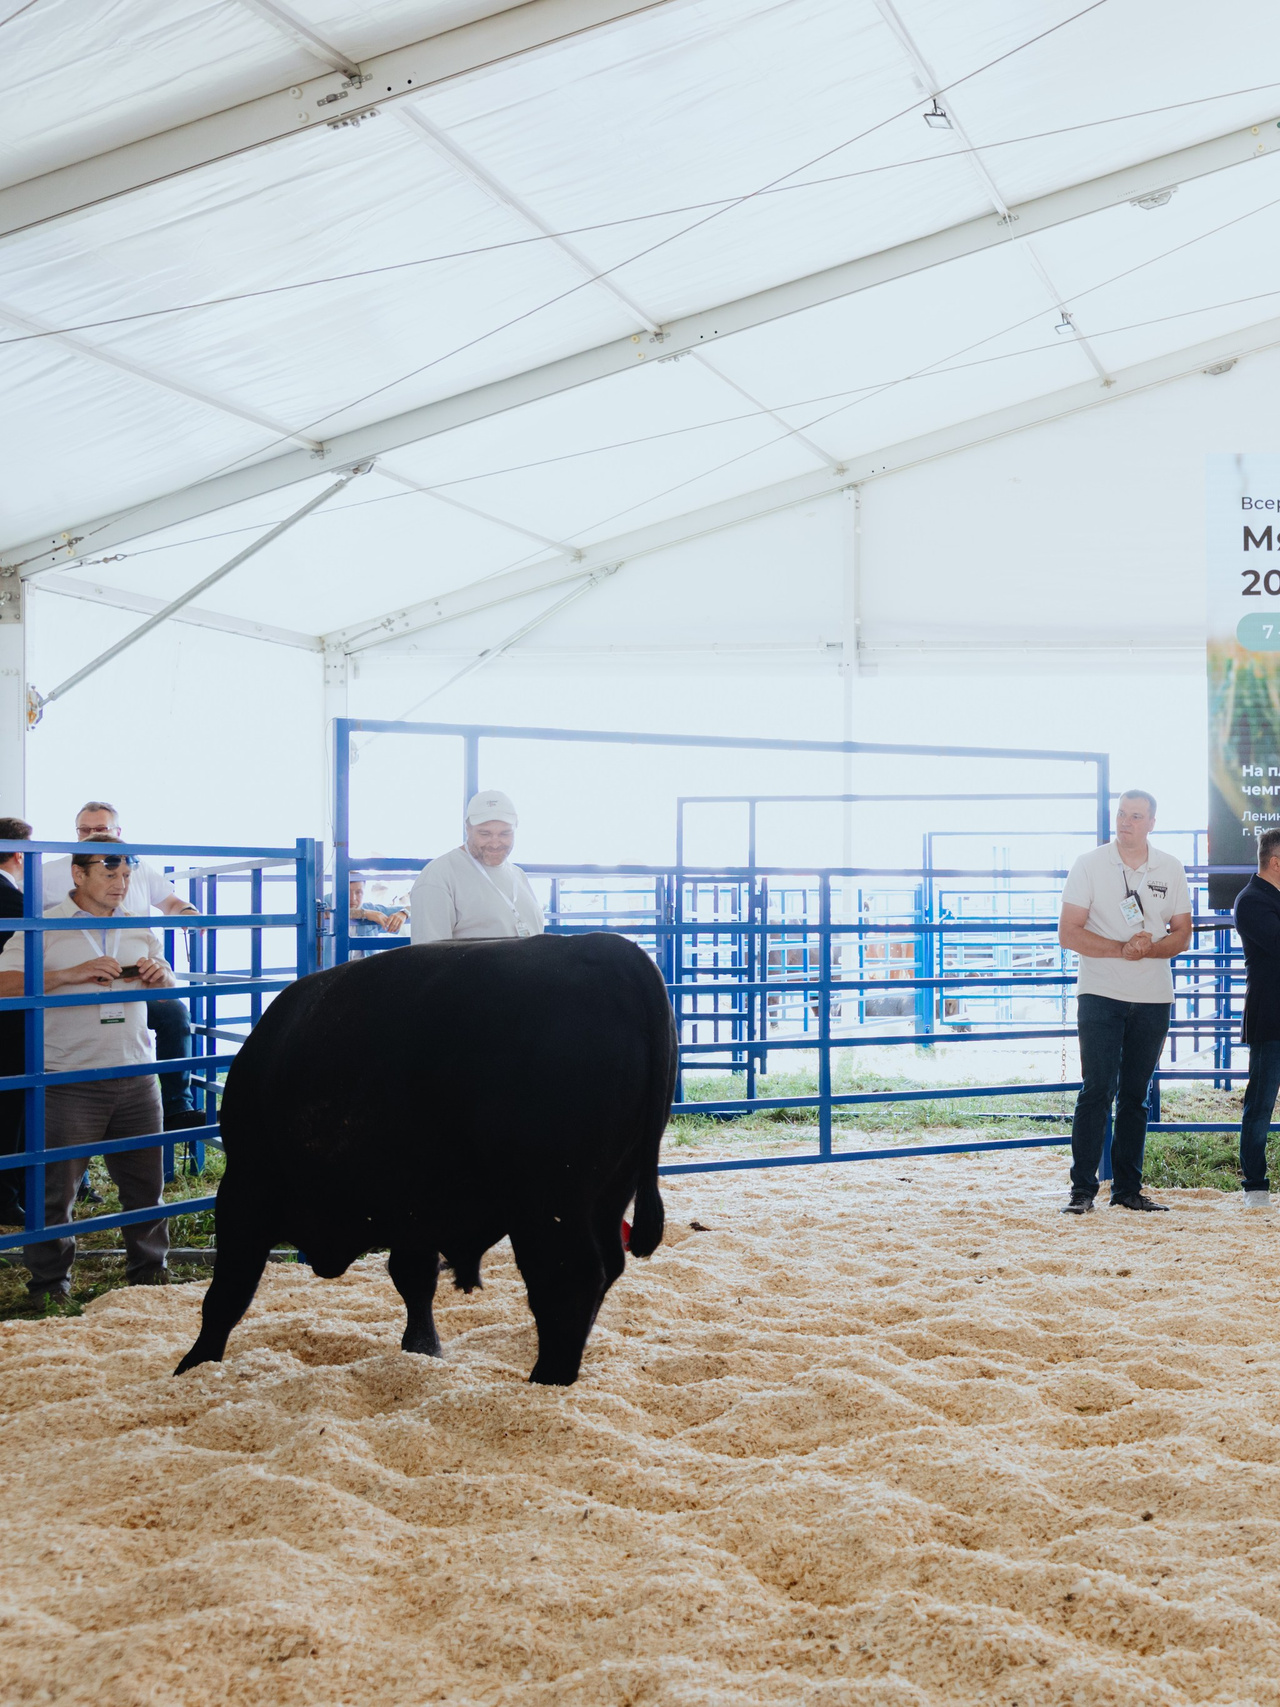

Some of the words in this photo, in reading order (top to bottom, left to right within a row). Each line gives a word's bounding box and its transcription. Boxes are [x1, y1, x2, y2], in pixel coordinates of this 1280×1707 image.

[1262, 625, 1274, 639] 7
[1242, 764, 1264, 777] На
[1242, 828, 1251, 836] г.
